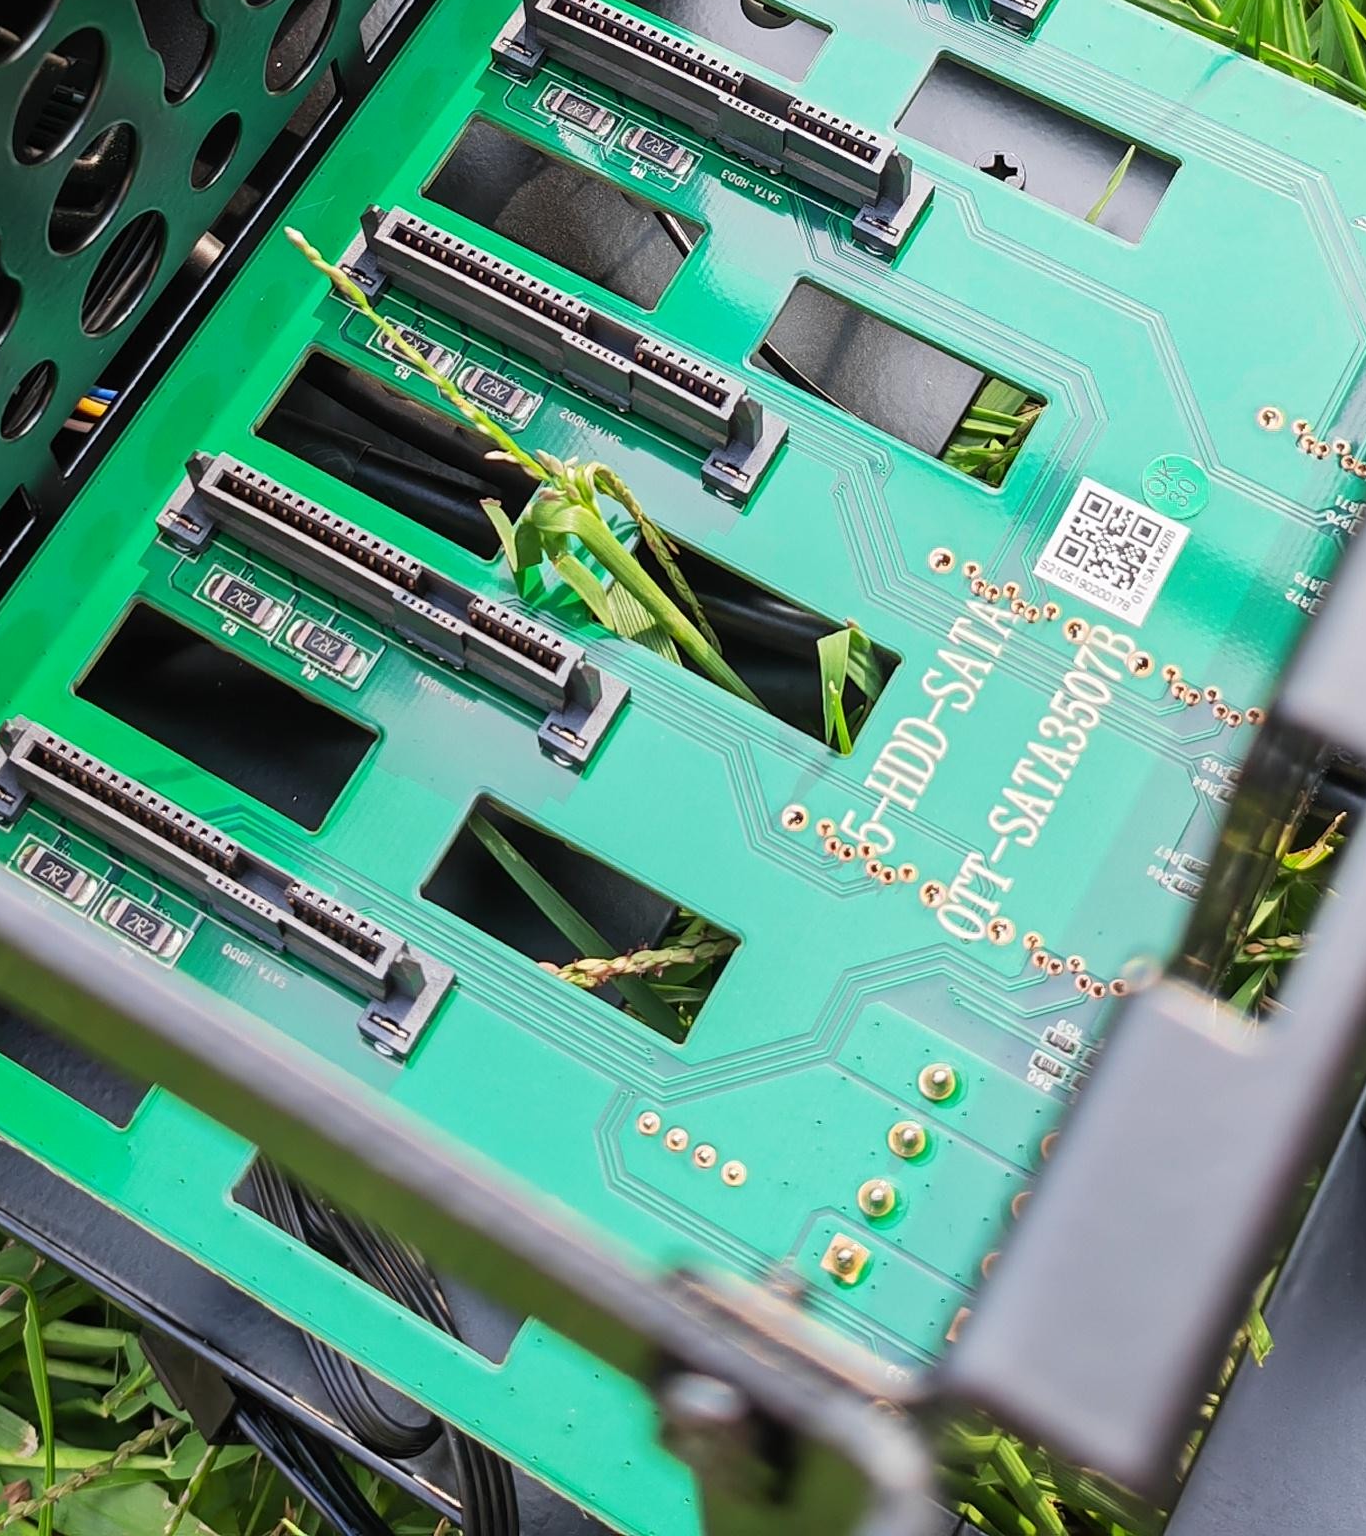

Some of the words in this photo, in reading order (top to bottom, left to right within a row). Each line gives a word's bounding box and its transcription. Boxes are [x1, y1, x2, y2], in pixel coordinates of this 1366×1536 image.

[564, 100, 592, 122] 2R2
[644, 135, 670, 158] 2R2
[720, 169, 783, 205] SATA-HDD3
[394, 366, 412, 380] R5
[481, 377, 510, 402] 2R2
[1146, 458, 1182, 496] OK
[1169, 478, 1197, 508] 30
[227, 589, 257, 614] 2R2
[311, 632, 341, 658] 2R2
[300, 663, 319, 681] R4
[840, 598, 1021, 854] 5-HDD-SATA
[936, 624, 1137, 941] OTT-SATA3507B
[39, 861, 71, 889] 2R2
[124, 912, 156, 941] 2R2
